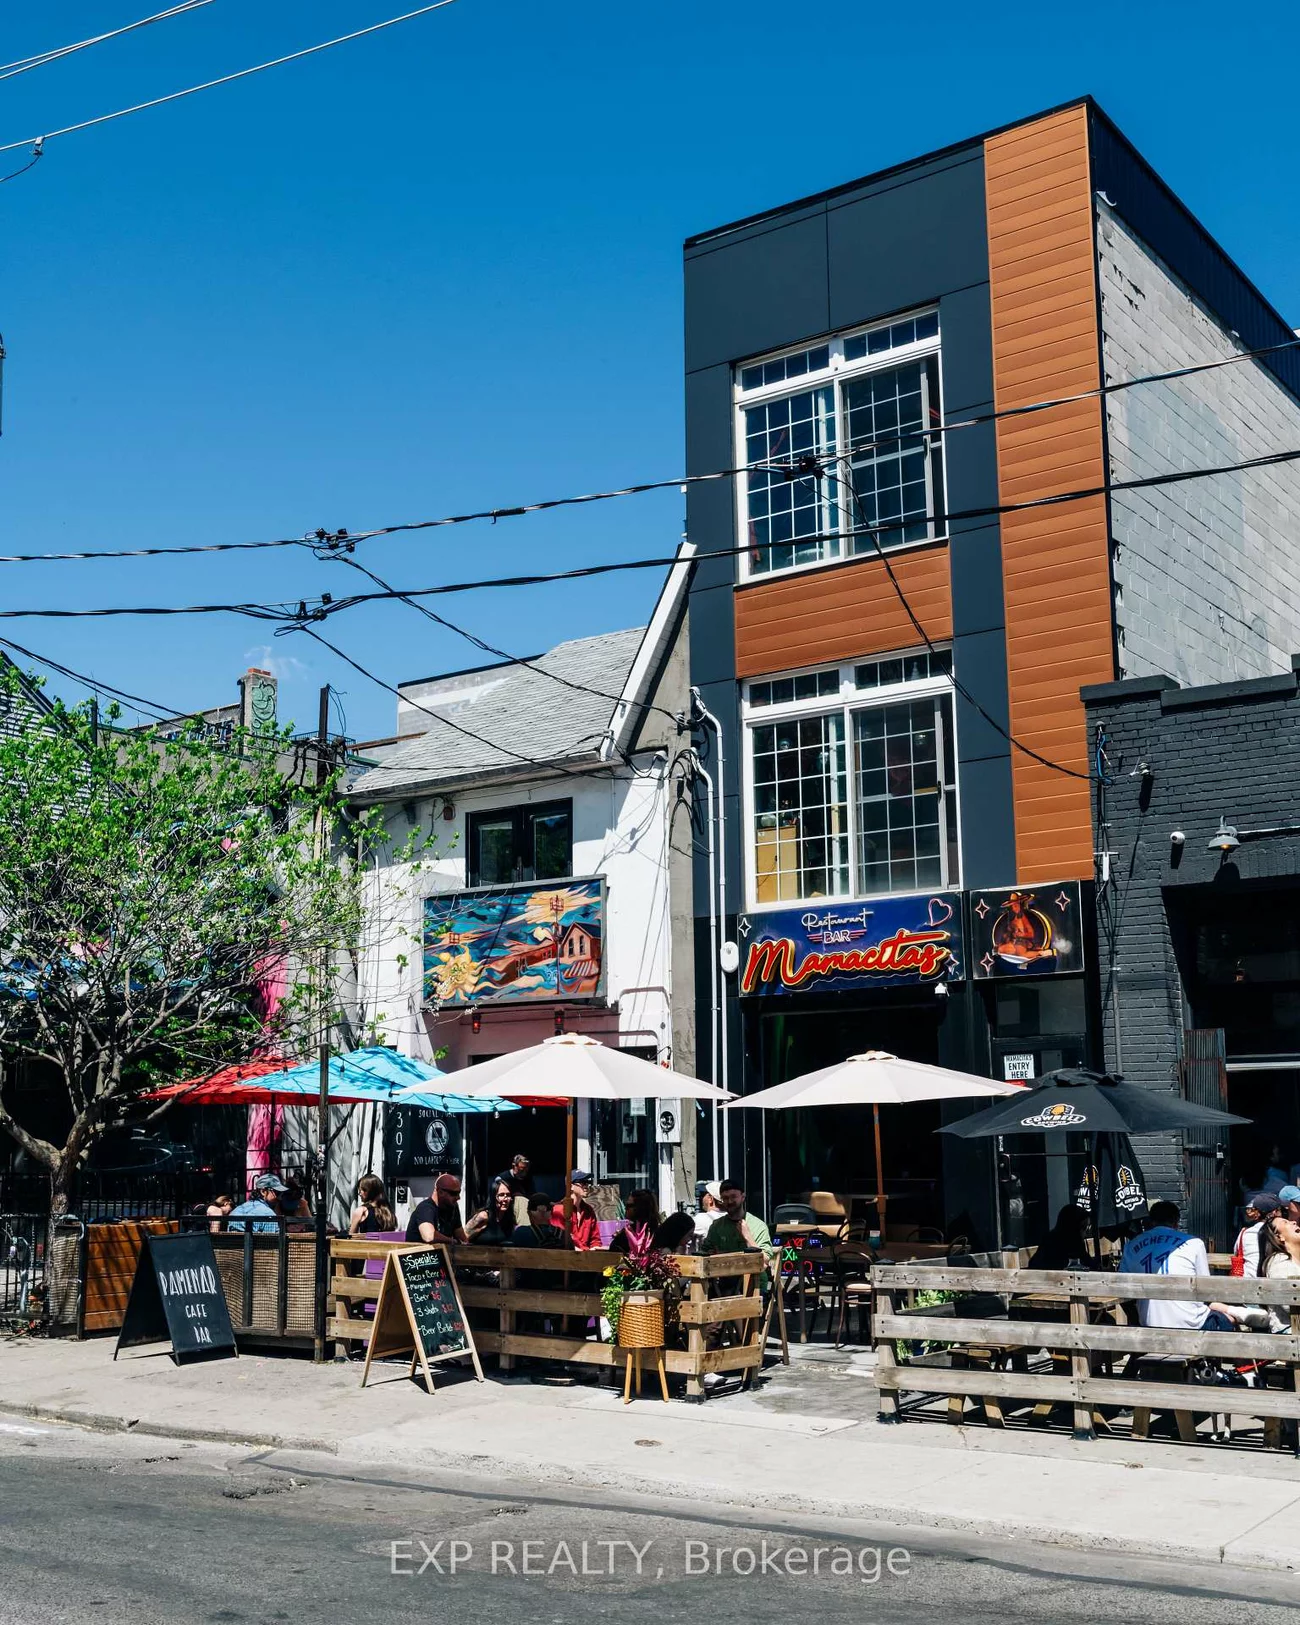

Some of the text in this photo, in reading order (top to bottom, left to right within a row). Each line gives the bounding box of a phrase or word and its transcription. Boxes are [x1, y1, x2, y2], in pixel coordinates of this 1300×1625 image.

[801, 907, 874, 931] Restaurant
[823, 929, 851, 945] BAR
[741, 927, 951, 993] Mamacitas
[1008, 1061, 1030, 1071] ENTRY
[1011, 1070, 1029, 1079] HERE
[1025, 1114, 1080, 1124] COWBELL
[1133, 1234, 1189, 1254] BICHETTE
[406, 1253, 437, 1270] Specials
[425, 1269, 440, 1279] Beer
[413, 1292, 430, 1303] Beer
[185, 1303, 208, 1318] CAFE
[193, 1325, 213, 1344] BAR
